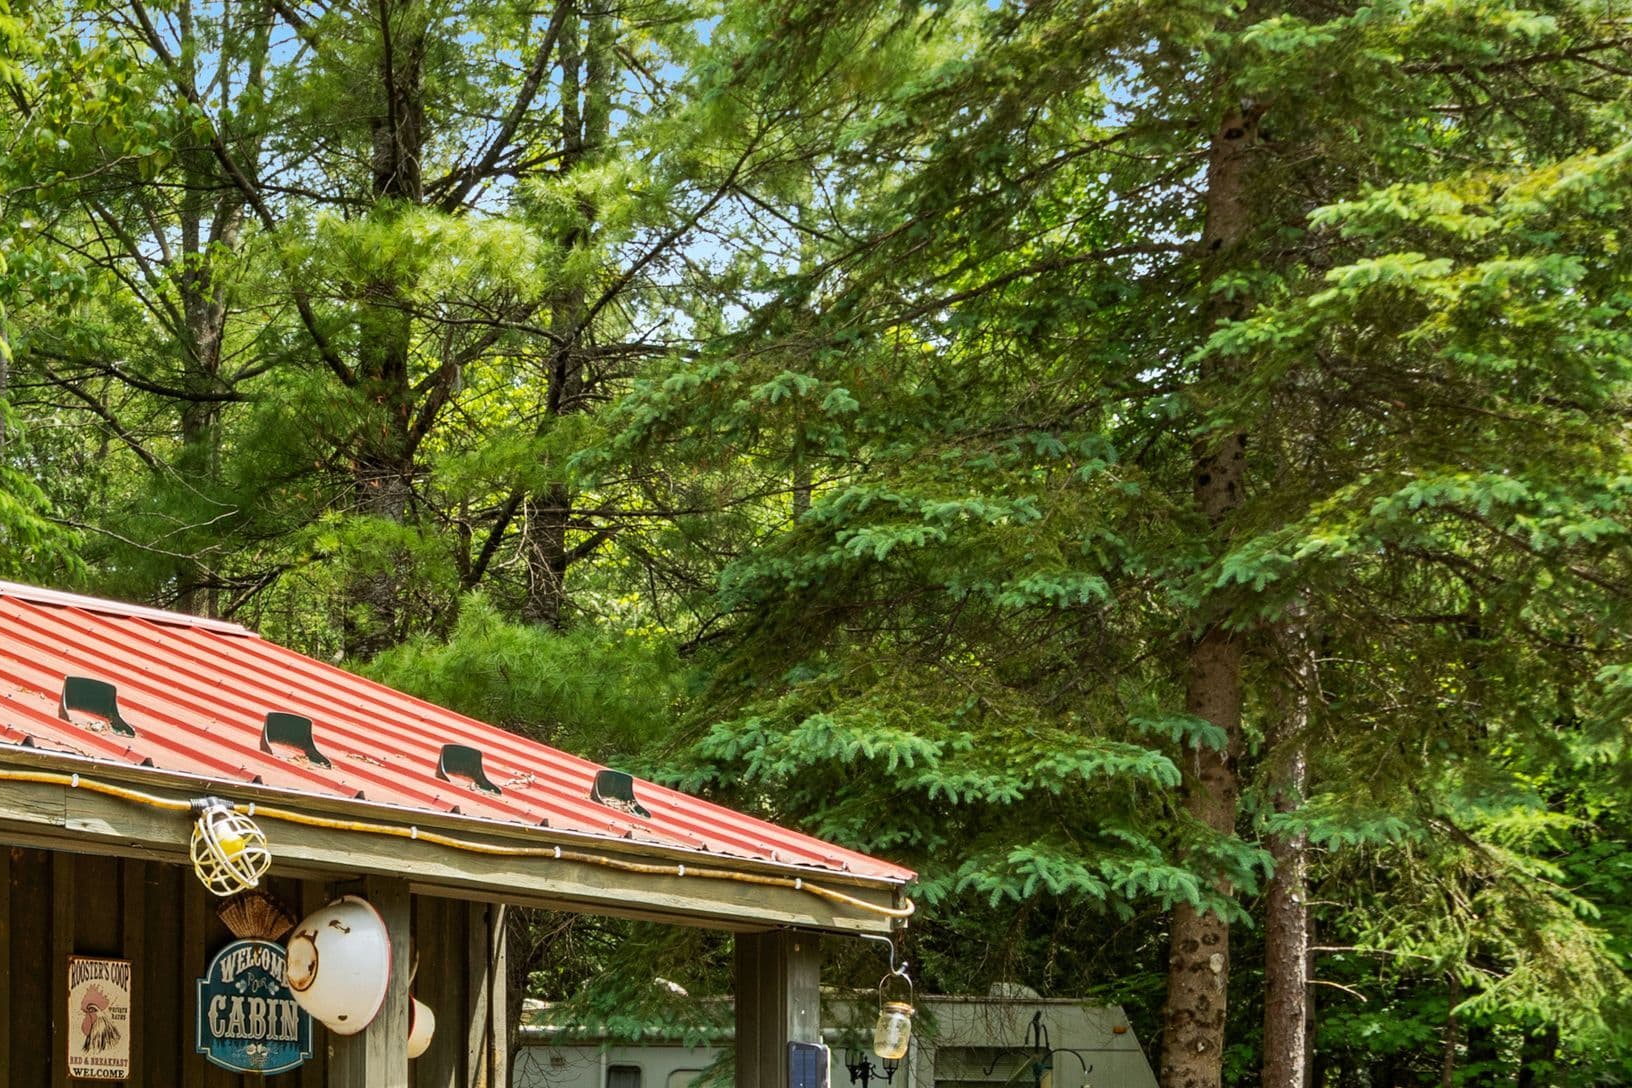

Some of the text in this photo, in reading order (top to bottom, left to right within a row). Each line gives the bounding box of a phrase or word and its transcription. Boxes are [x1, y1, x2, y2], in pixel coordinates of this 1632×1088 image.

[111, 962, 129, 992] COOP
[208, 995, 299, 1041] CABIN
[91, 1058, 128, 1067] BREAKFAST
[73, 1068, 125, 1078] WELCOME
